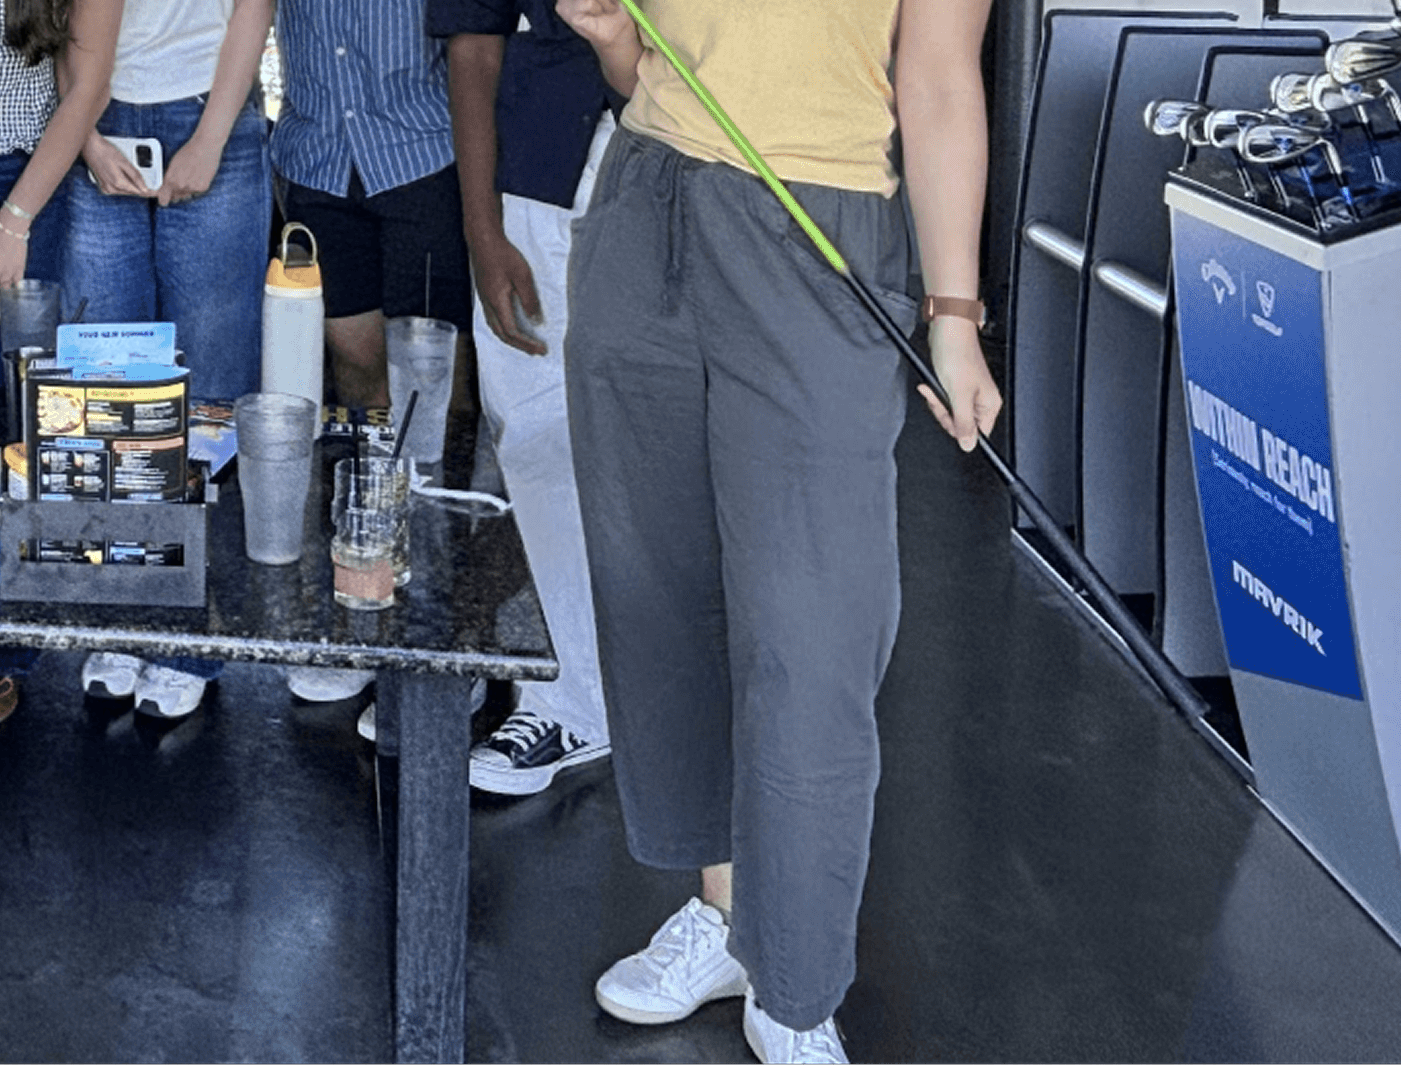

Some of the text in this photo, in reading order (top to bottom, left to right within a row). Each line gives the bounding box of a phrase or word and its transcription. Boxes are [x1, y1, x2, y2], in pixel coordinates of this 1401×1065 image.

[1187, 379, 1261, 472] WITHIN
[1261, 427, 1336, 524] REACH
[1232, 558, 1327, 657] MAVRIK
